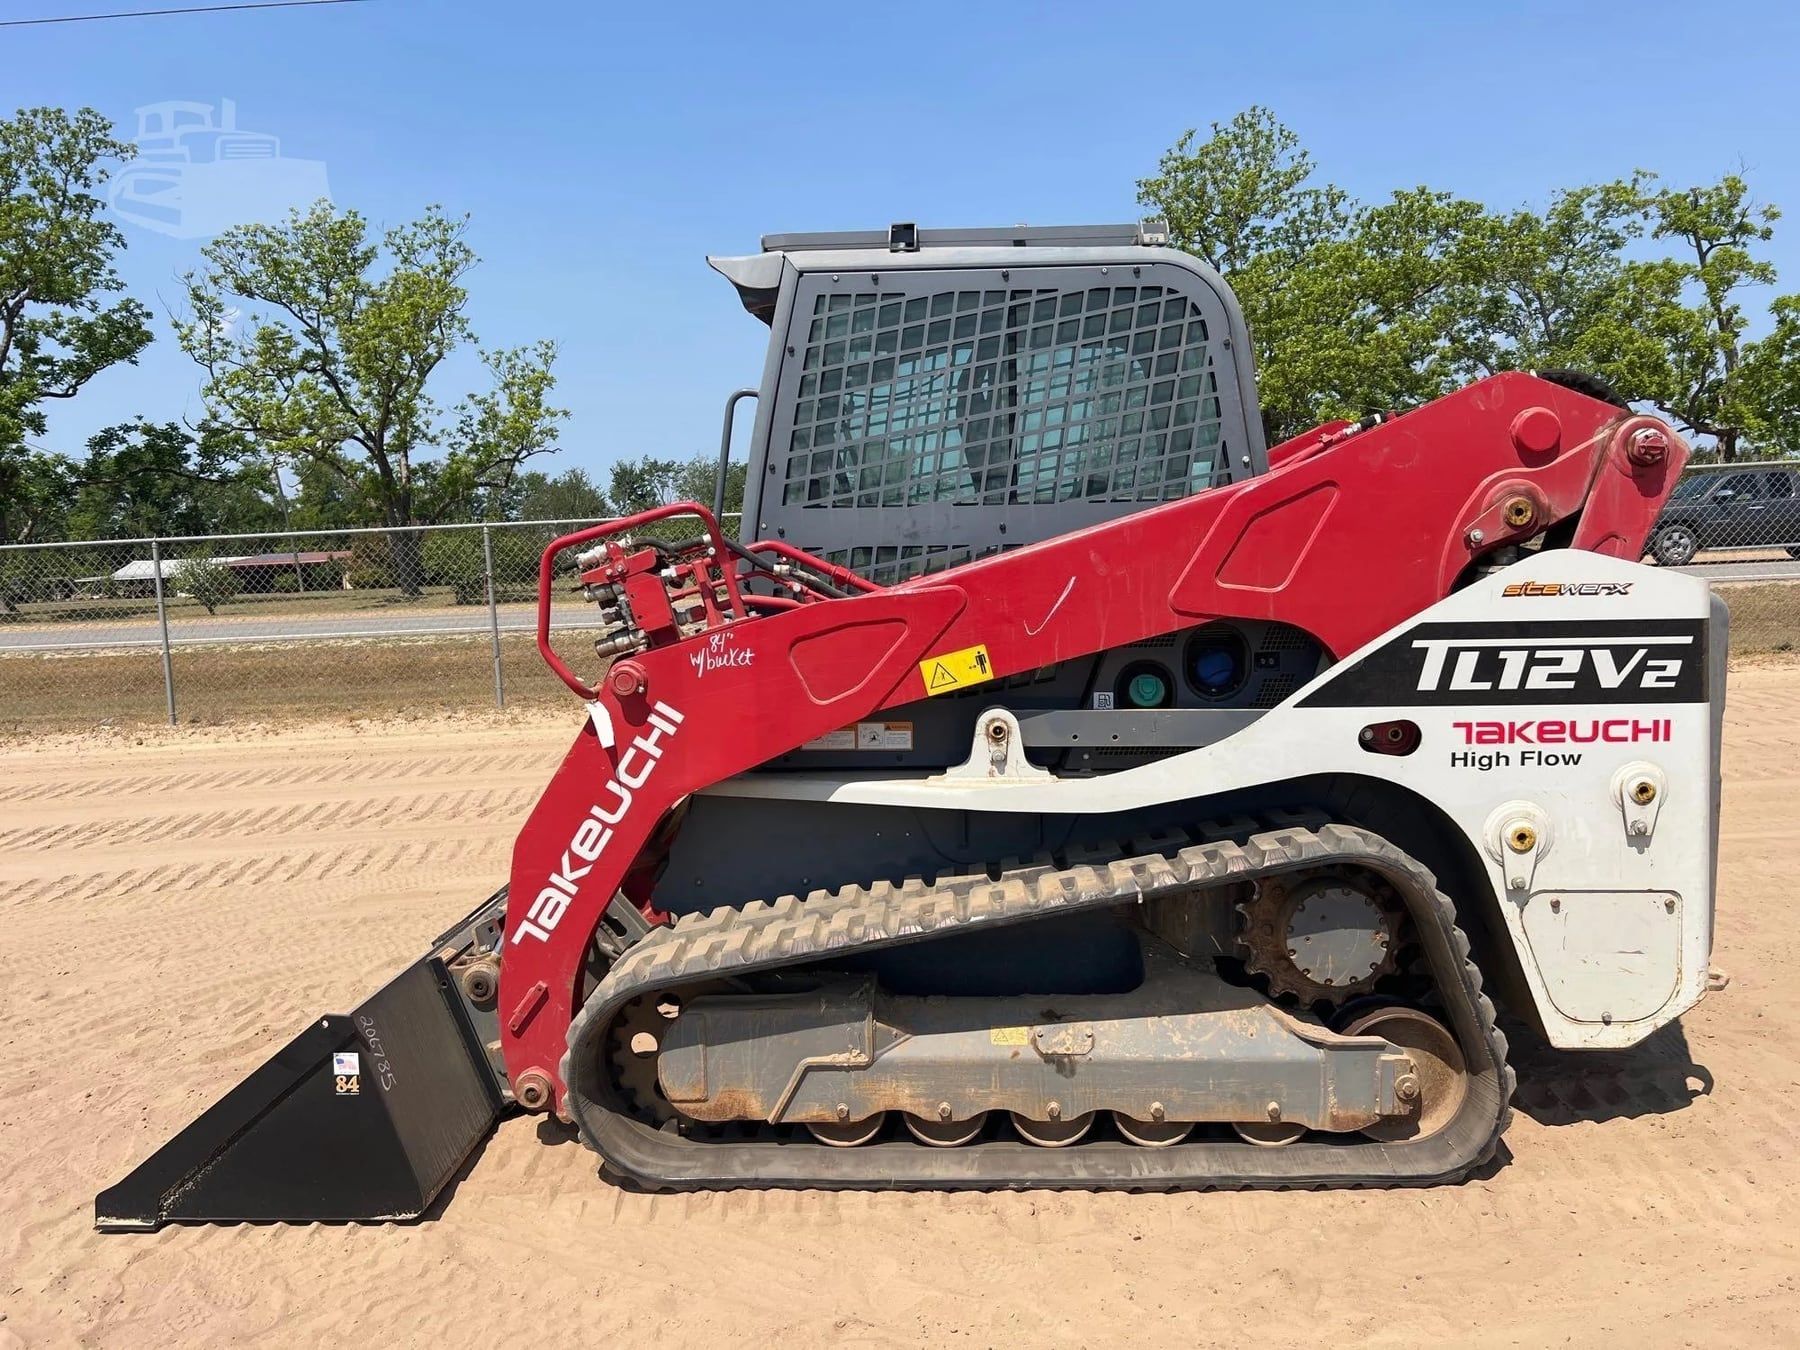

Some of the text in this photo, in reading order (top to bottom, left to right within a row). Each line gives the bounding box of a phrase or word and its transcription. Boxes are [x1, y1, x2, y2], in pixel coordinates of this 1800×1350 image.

[1502, 581, 1634, 597] sitewerx
[1411, 636, 1694, 691] TL12V2
[1452, 719, 1672, 745] TAKEUCHI
[1450, 750, 1582, 771] High Flow
[510, 700, 686, 945] TAKEUCHI
[359, 1015, 398, 1092] 206785
[335, 1075, 360, 1093] 84
